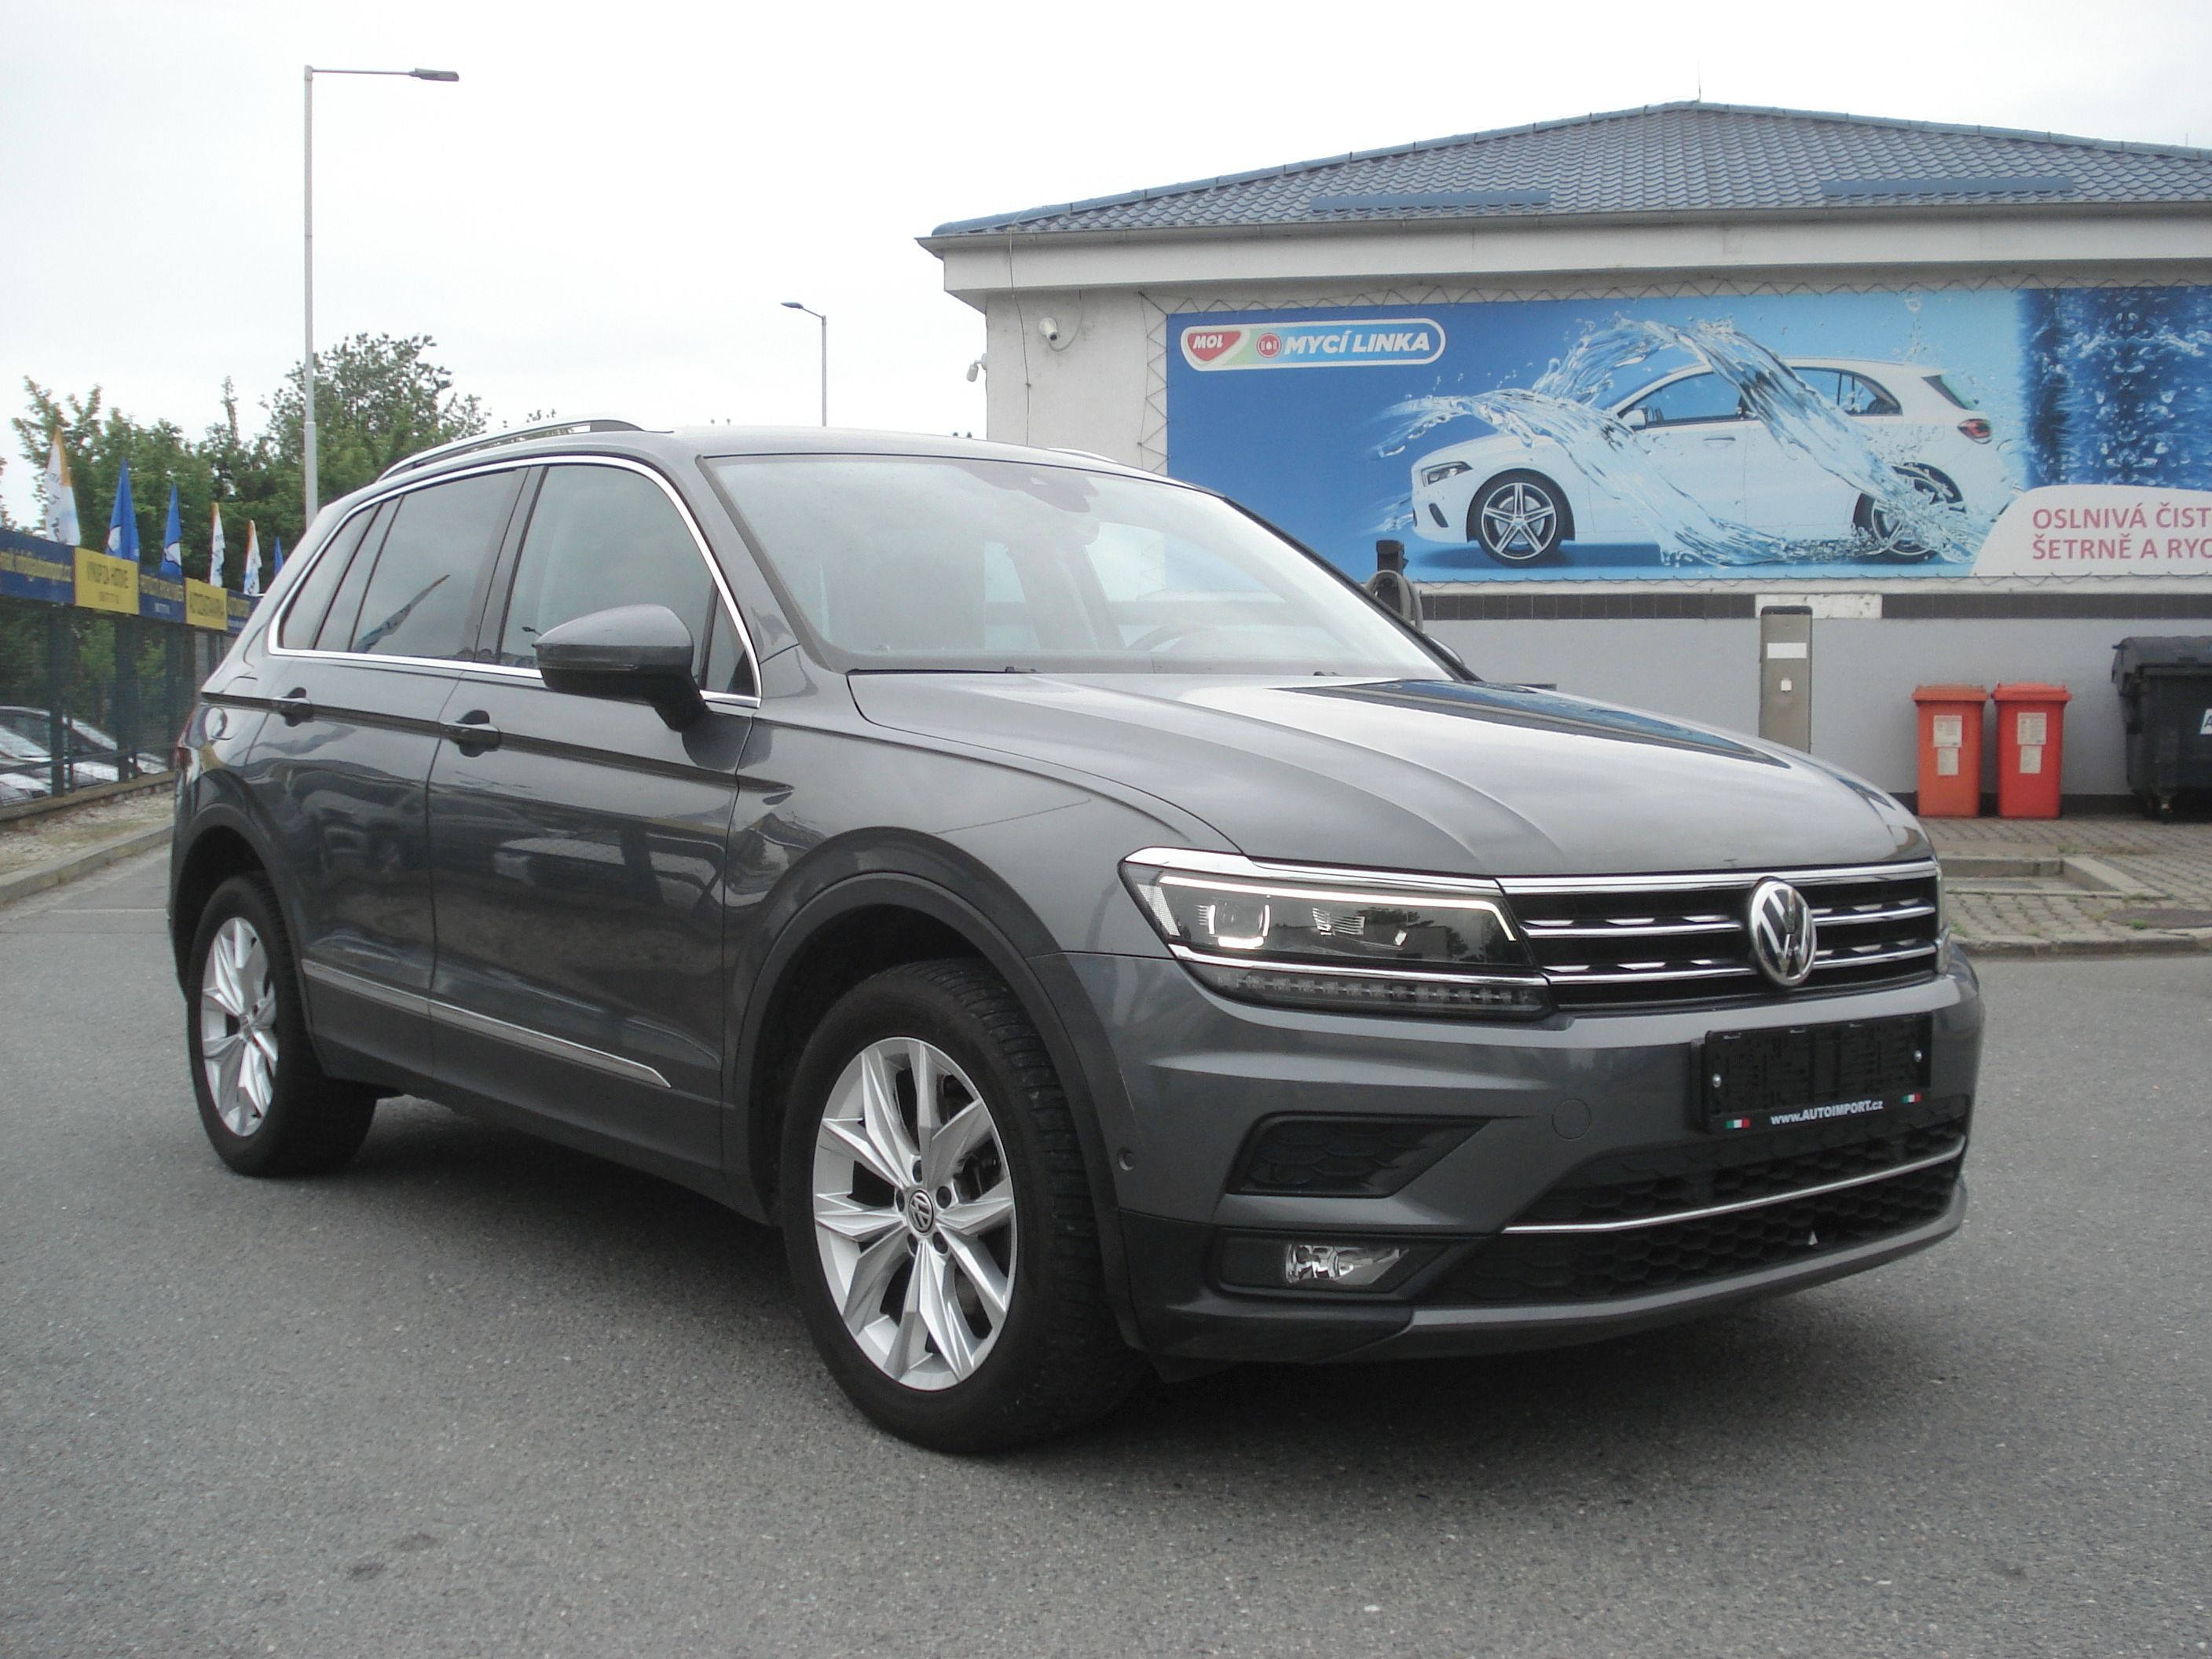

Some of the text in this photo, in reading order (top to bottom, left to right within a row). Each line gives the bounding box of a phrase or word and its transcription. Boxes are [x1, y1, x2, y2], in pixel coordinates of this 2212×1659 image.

[1192, 334, 1224, 349] MOL
[1284, 330, 1430, 355] MYCÍ LINKA
[2032, 502, 2148, 529] OSLNIVÁ
[2032, 533, 2132, 560] ŠETRNĚ
[2140, 538, 2159, 558] A
[1770, 1100, 1884, 1125] www.AUTOIMPORT.cz
